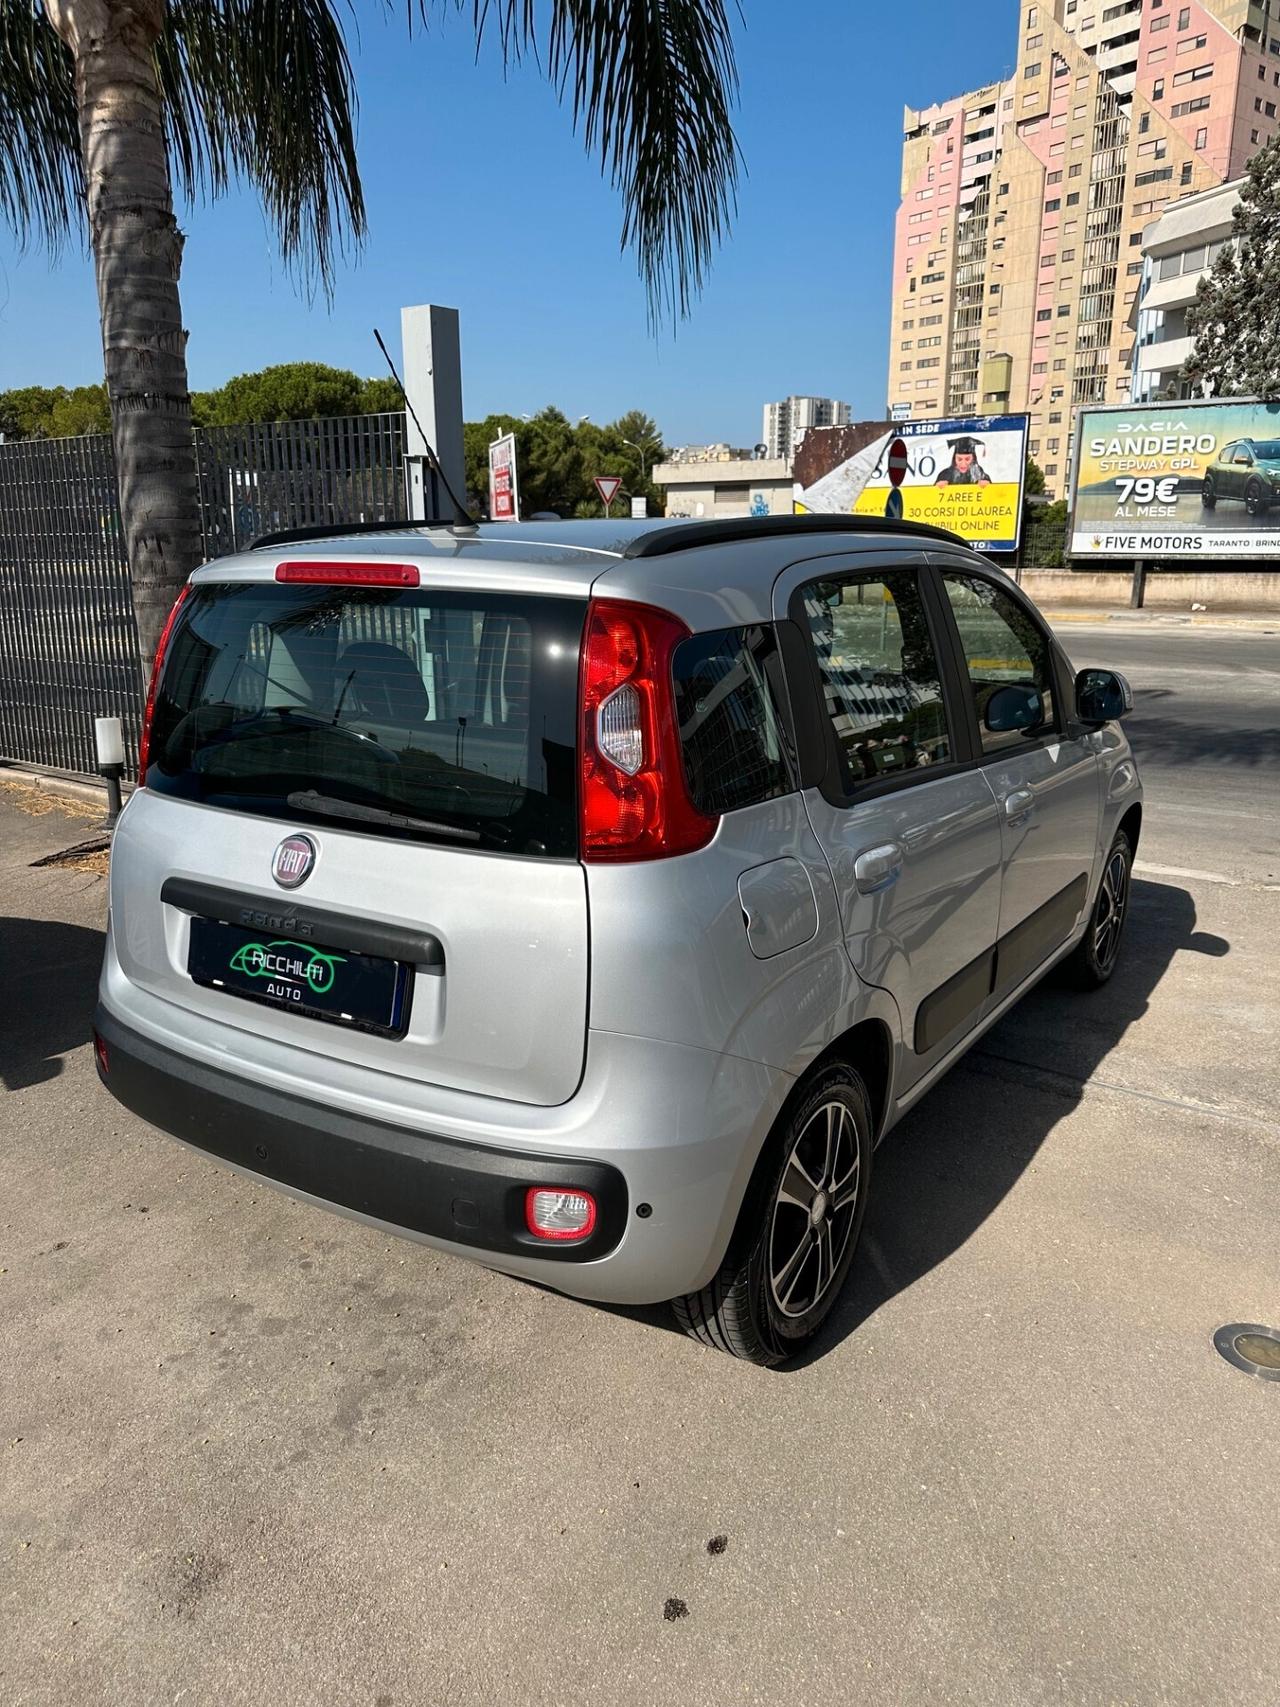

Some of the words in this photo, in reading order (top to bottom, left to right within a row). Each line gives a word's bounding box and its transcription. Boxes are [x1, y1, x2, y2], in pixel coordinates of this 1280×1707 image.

[902, 426, 913, 435] IN
[915, 424, 940, 434] SEDE
[1117, 422, 1188, 432] DACIA
[1090, 434, 1216, 456] SANDERO
[1100, 460, 1166, 471] STEPWAY
[1170, 458, 1199, 470] GPL
[939, 493, 945, 503] 7
[947, 492, 974, 502] AREE
[976, 492, 983, 502] E
[1114, 478, 1179, 504] 79€
[909, 507, 921, 518] 30
[924, 507, 955, 517] CORSI
[957, 507, 968, 516] DI
[970, 505, 1013, 517] LAUREA
[1114, 508, 1133, 517] AL
[1136, 506, 1176, 517] MESE
[960, 520, 1000, 531] ONLINE
[1105, 537, 1137, 549] FIVE
[1140, 536, 1203, 549] MOTORS
[278, 849, 306, 873] FIAT
[267, 984, 301, 1000] AUTO
